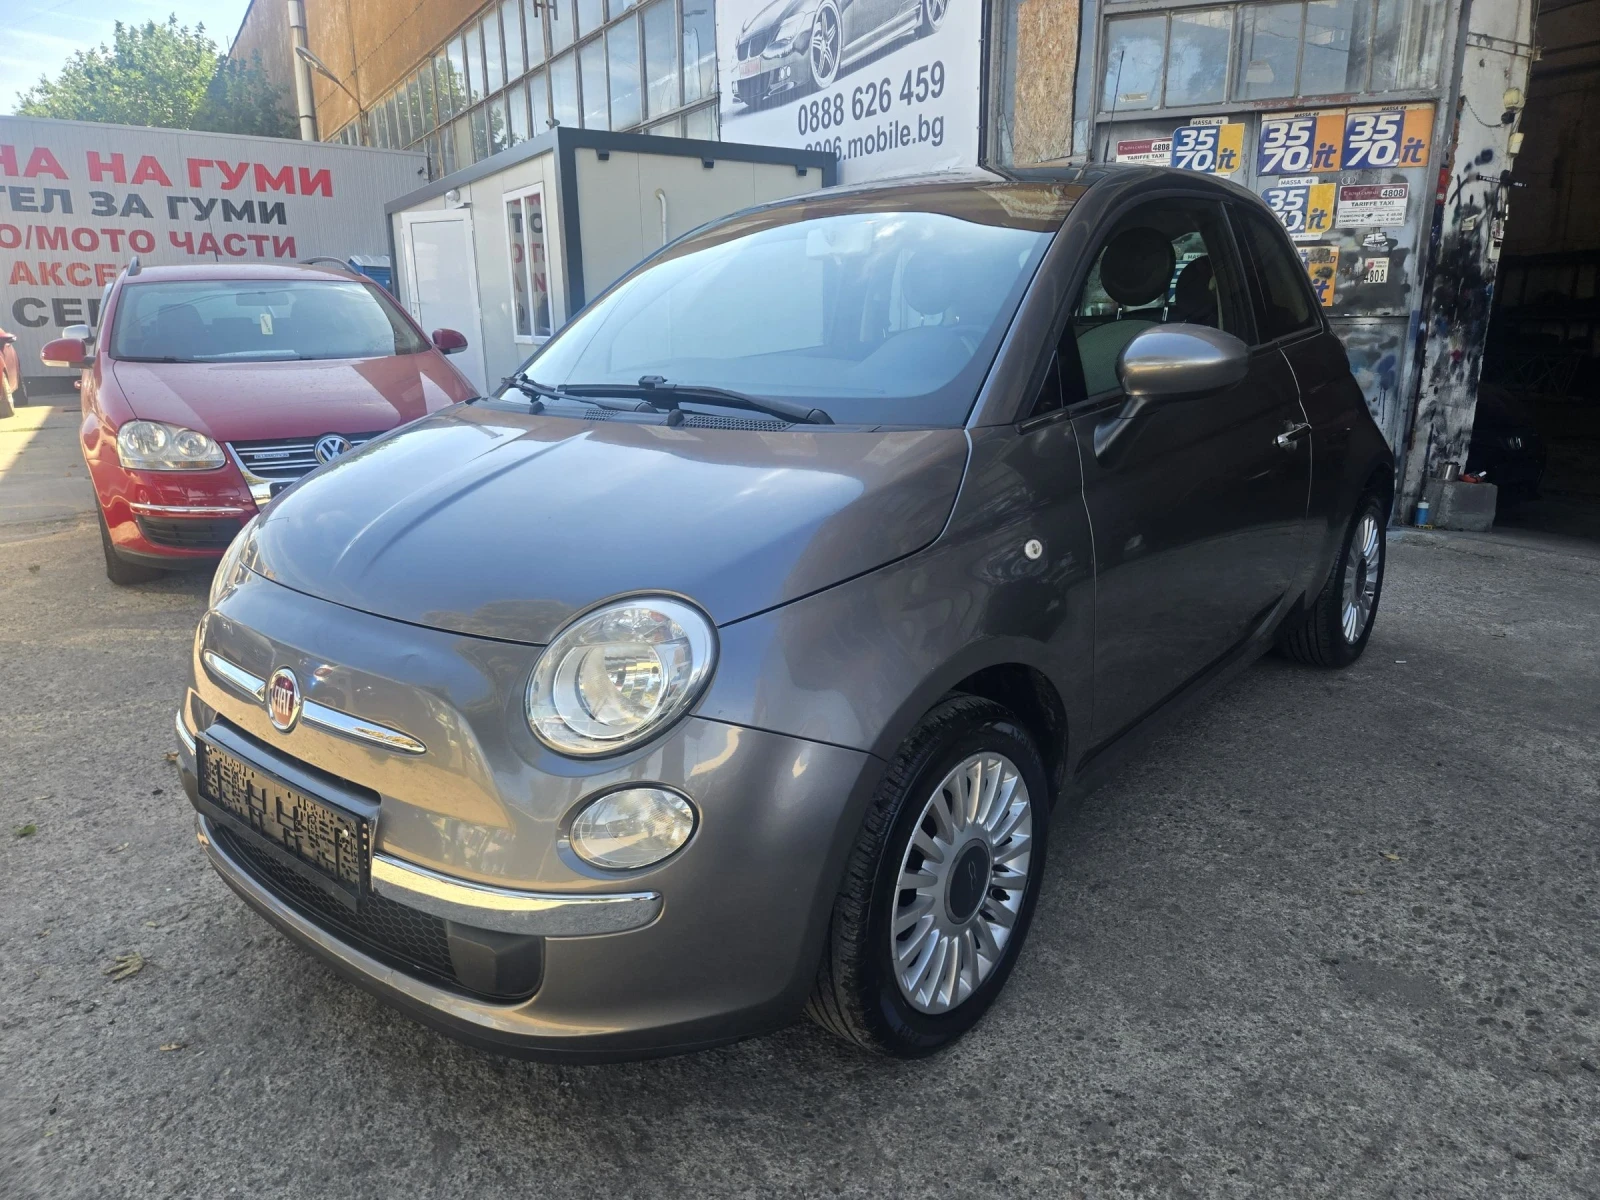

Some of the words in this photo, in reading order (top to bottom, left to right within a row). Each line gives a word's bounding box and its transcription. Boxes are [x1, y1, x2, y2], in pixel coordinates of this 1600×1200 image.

[798, 92, 844, 136] 0888
[851, 77, 892, 121] 626
[899, 60, 945, 106] 459
[804, 113, 944, 162] 6.mobile.bg
[1176, 128, 1217, 151] 35
[1263, 120, 1313, 148] 35
[1349, 114, 1400, 141] 35
[1152, 143, 1170, 151] 4808
[86, 151, 173, 187] НА
[187, 158, 333, 197] ГУМИ
[1268, 188, 1307, 212] 35
[1382, 189, 1404, 198] 4808
[89, 191, 154, 219] ЗА
[166, 195, 287, 226] ГУМИ
[168, 231, 297, 259] ЧАСТИ
[9, 260, 128, 287] АКСЕ
[273, 686, 293, 716] FIAT
